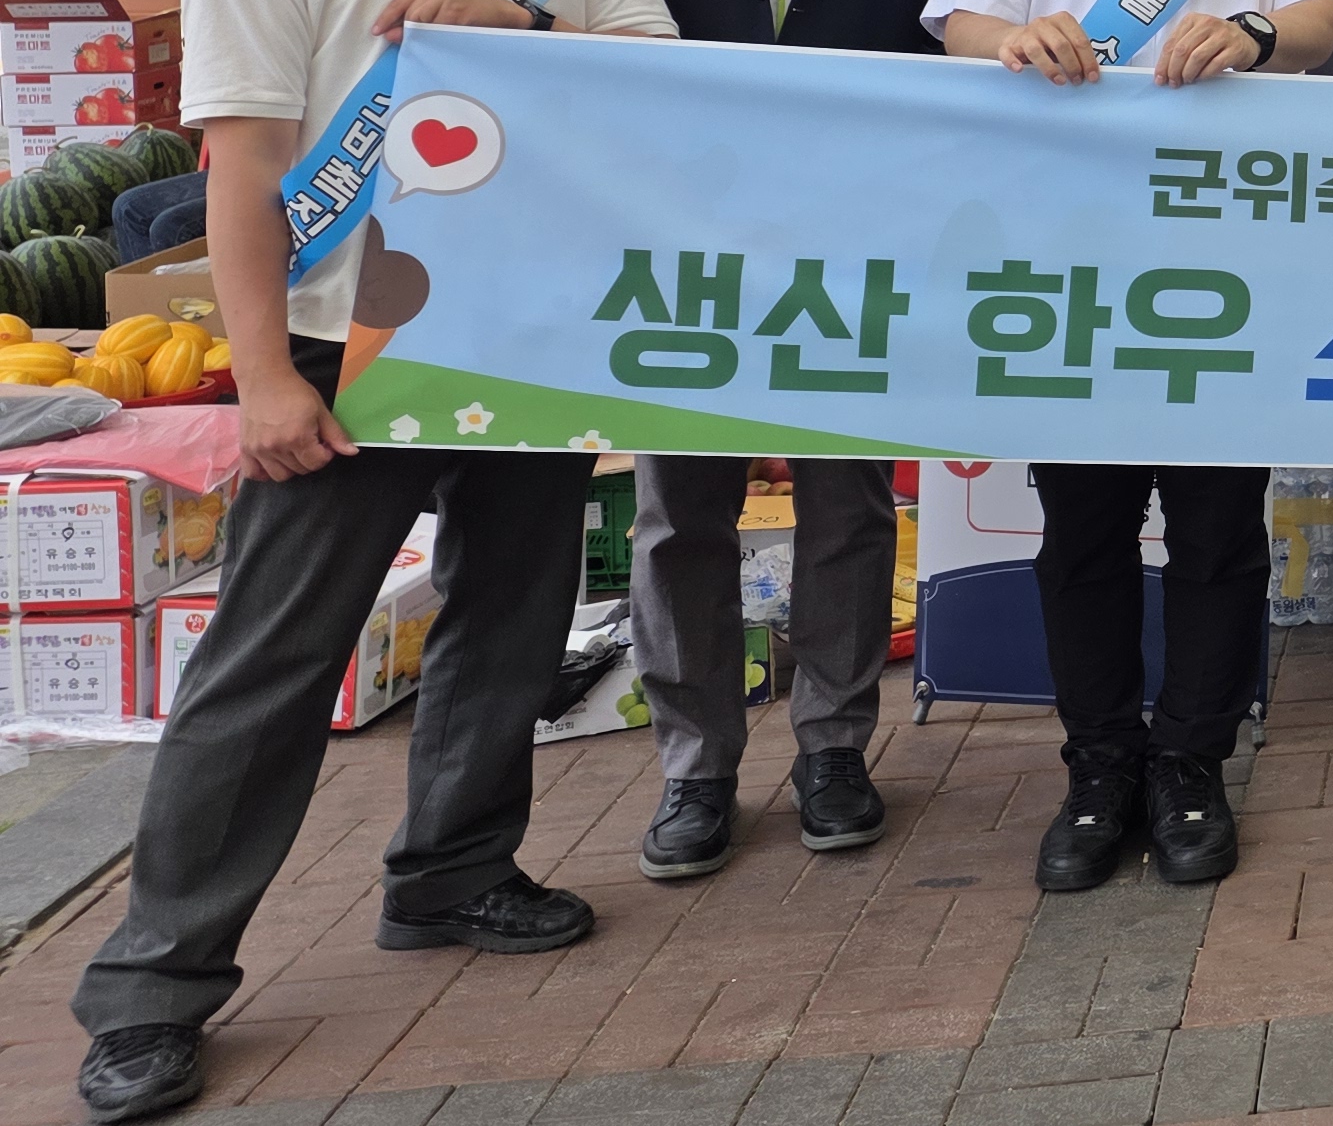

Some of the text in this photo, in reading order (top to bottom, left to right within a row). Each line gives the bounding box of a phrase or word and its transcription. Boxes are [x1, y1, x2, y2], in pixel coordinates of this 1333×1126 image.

[16, 40, 52, 51] 토마토
[17, 94, 52, 104] 토마토
[591, 248, 911, 393] 생산
[965, 259, 1255, 404] 한우
[1272, 596, 1316, 615] 동원샘물
